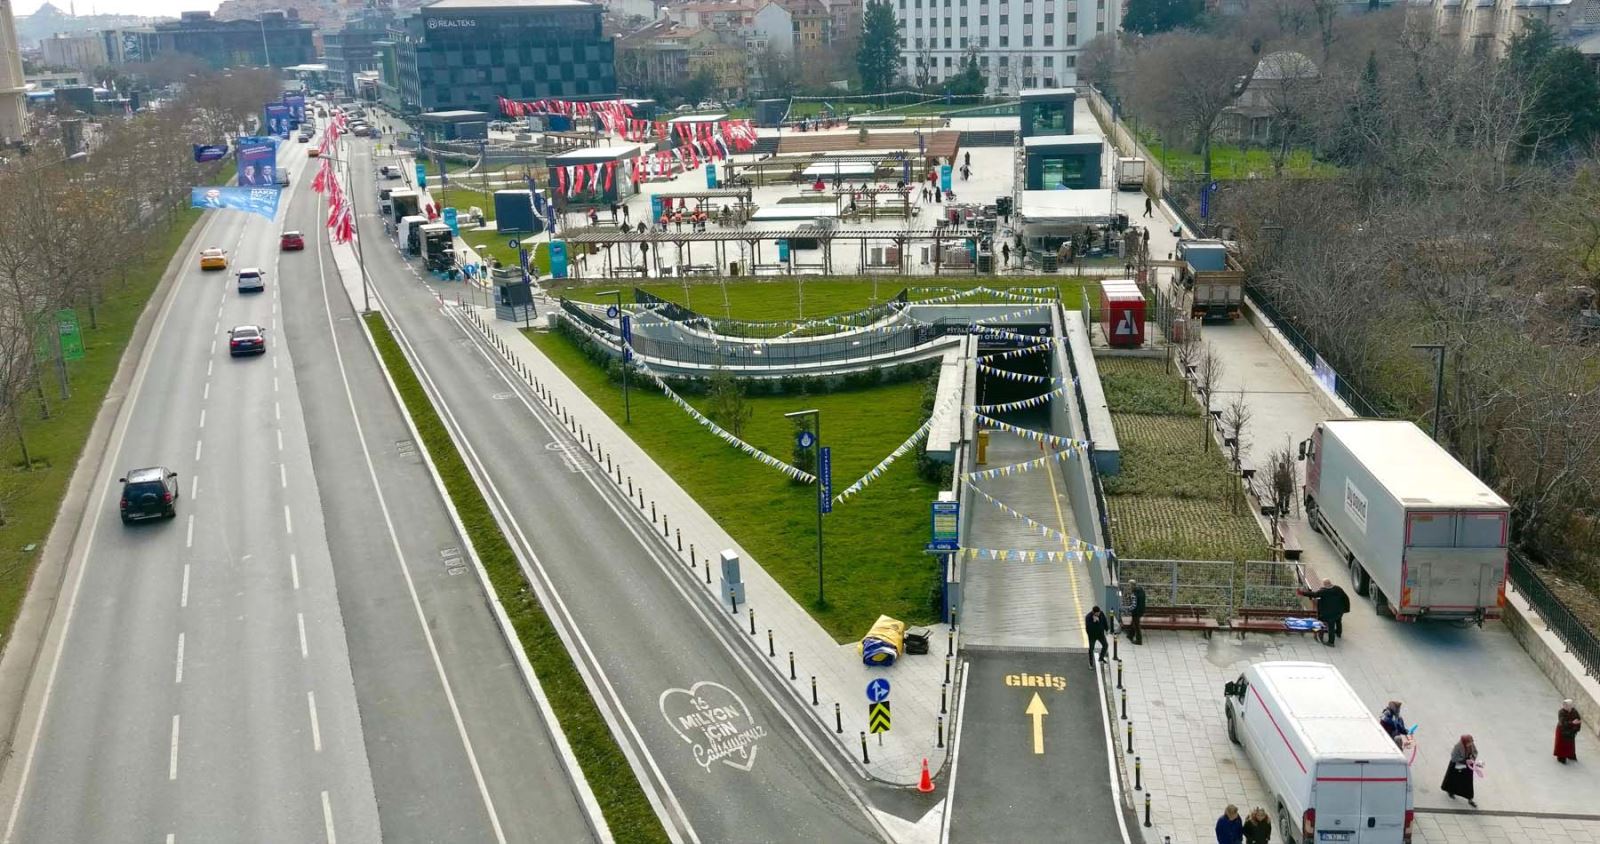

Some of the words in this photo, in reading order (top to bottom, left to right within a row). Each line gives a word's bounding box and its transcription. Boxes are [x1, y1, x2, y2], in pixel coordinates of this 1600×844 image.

[438, 19, 476, 27] REALTEKS
[1005, 673, 1067, 690] GİRİŞ
[678, 705, 740, 730] MİLYON
[700, 721, 738, 742] İÇİN
